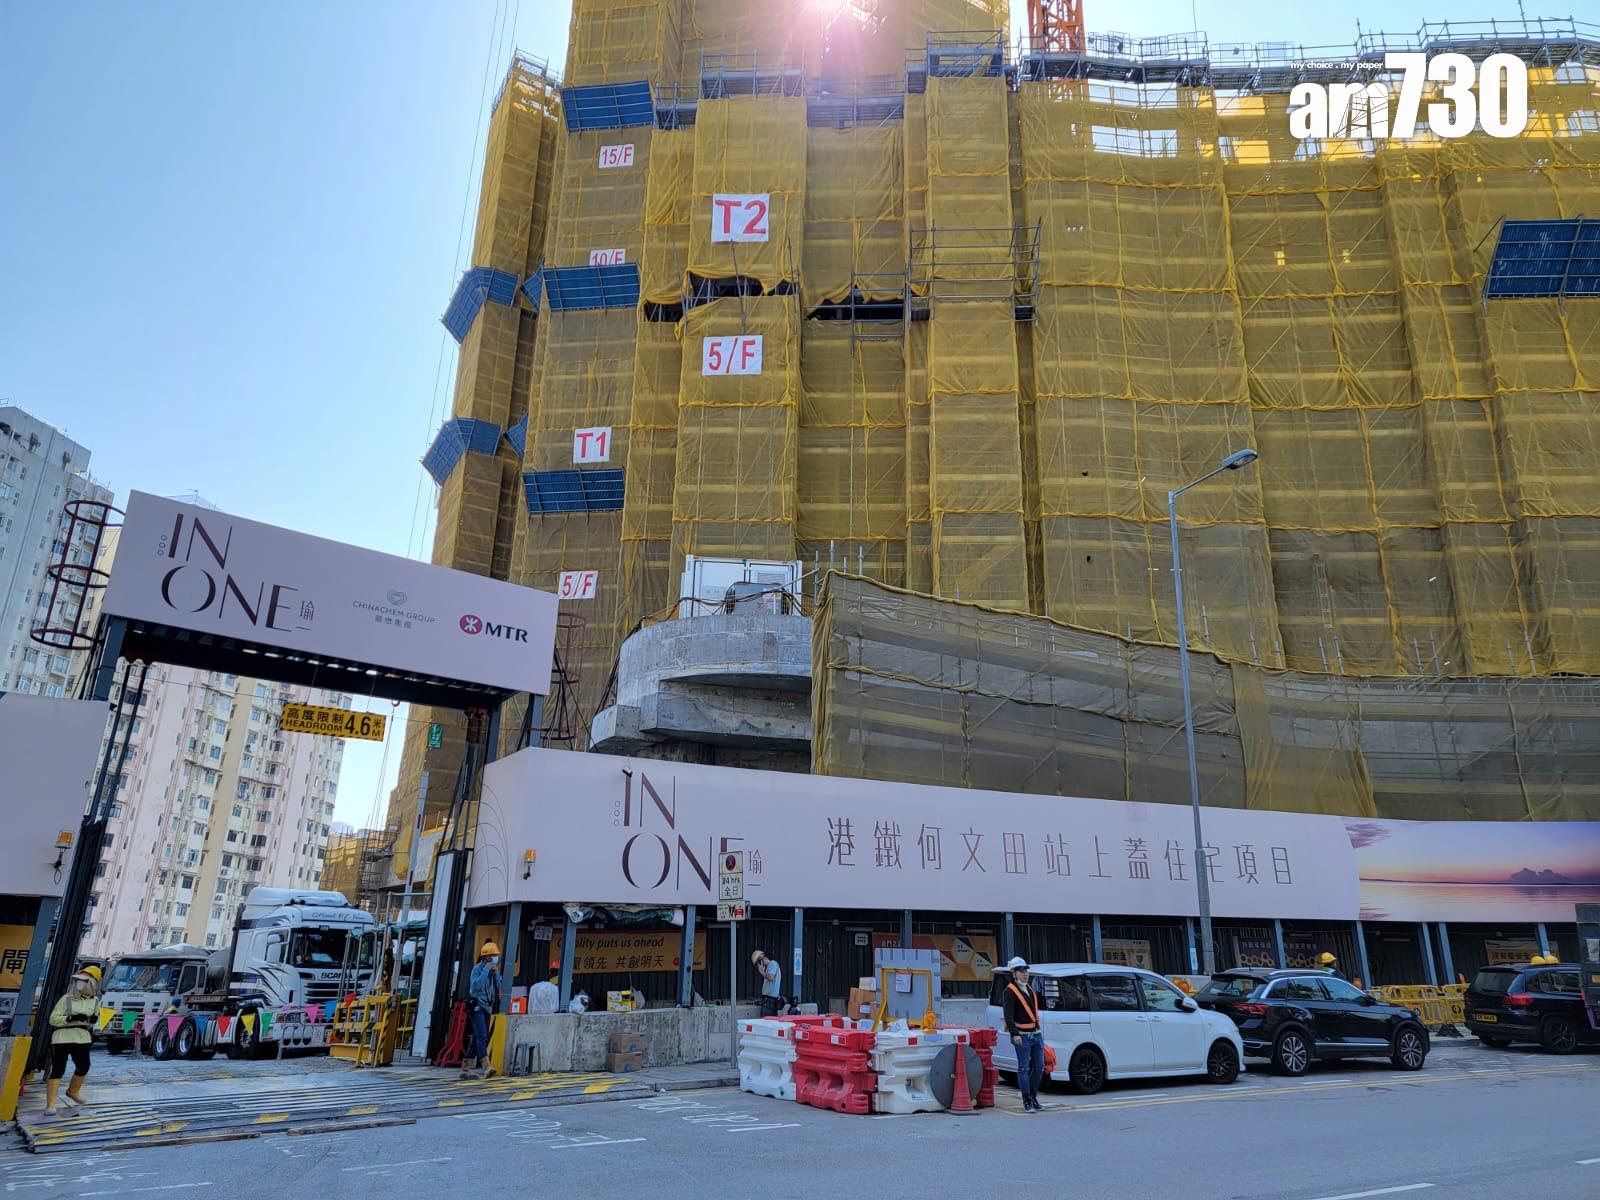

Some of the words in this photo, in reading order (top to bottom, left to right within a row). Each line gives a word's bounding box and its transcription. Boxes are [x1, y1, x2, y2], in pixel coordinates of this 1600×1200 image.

[602, 146, 632, 166] 15/F
[715, 200, 767, 235] T2
[708, 337, 756, 374] 5/F
[576, 431, 606, 458] T1
[168, 513, 233, 570] IN
[562, 573, 593, 597] 5/F
[161, 565, 299, 632] ONE
[406, 612, 436, 624] GROUP
[485, 621, 528, 643] MTR
[285, 719, 343, 732] HEADROOM
[287, 707, 345, 724] 高度限制
[344, 714, 371, 736] 4.6
[623, 772, 676, 830] IN
[597, 937, 618, 950] puts
[620, 939, 631, 947] us
[633, 936, 664, 947] ahead
